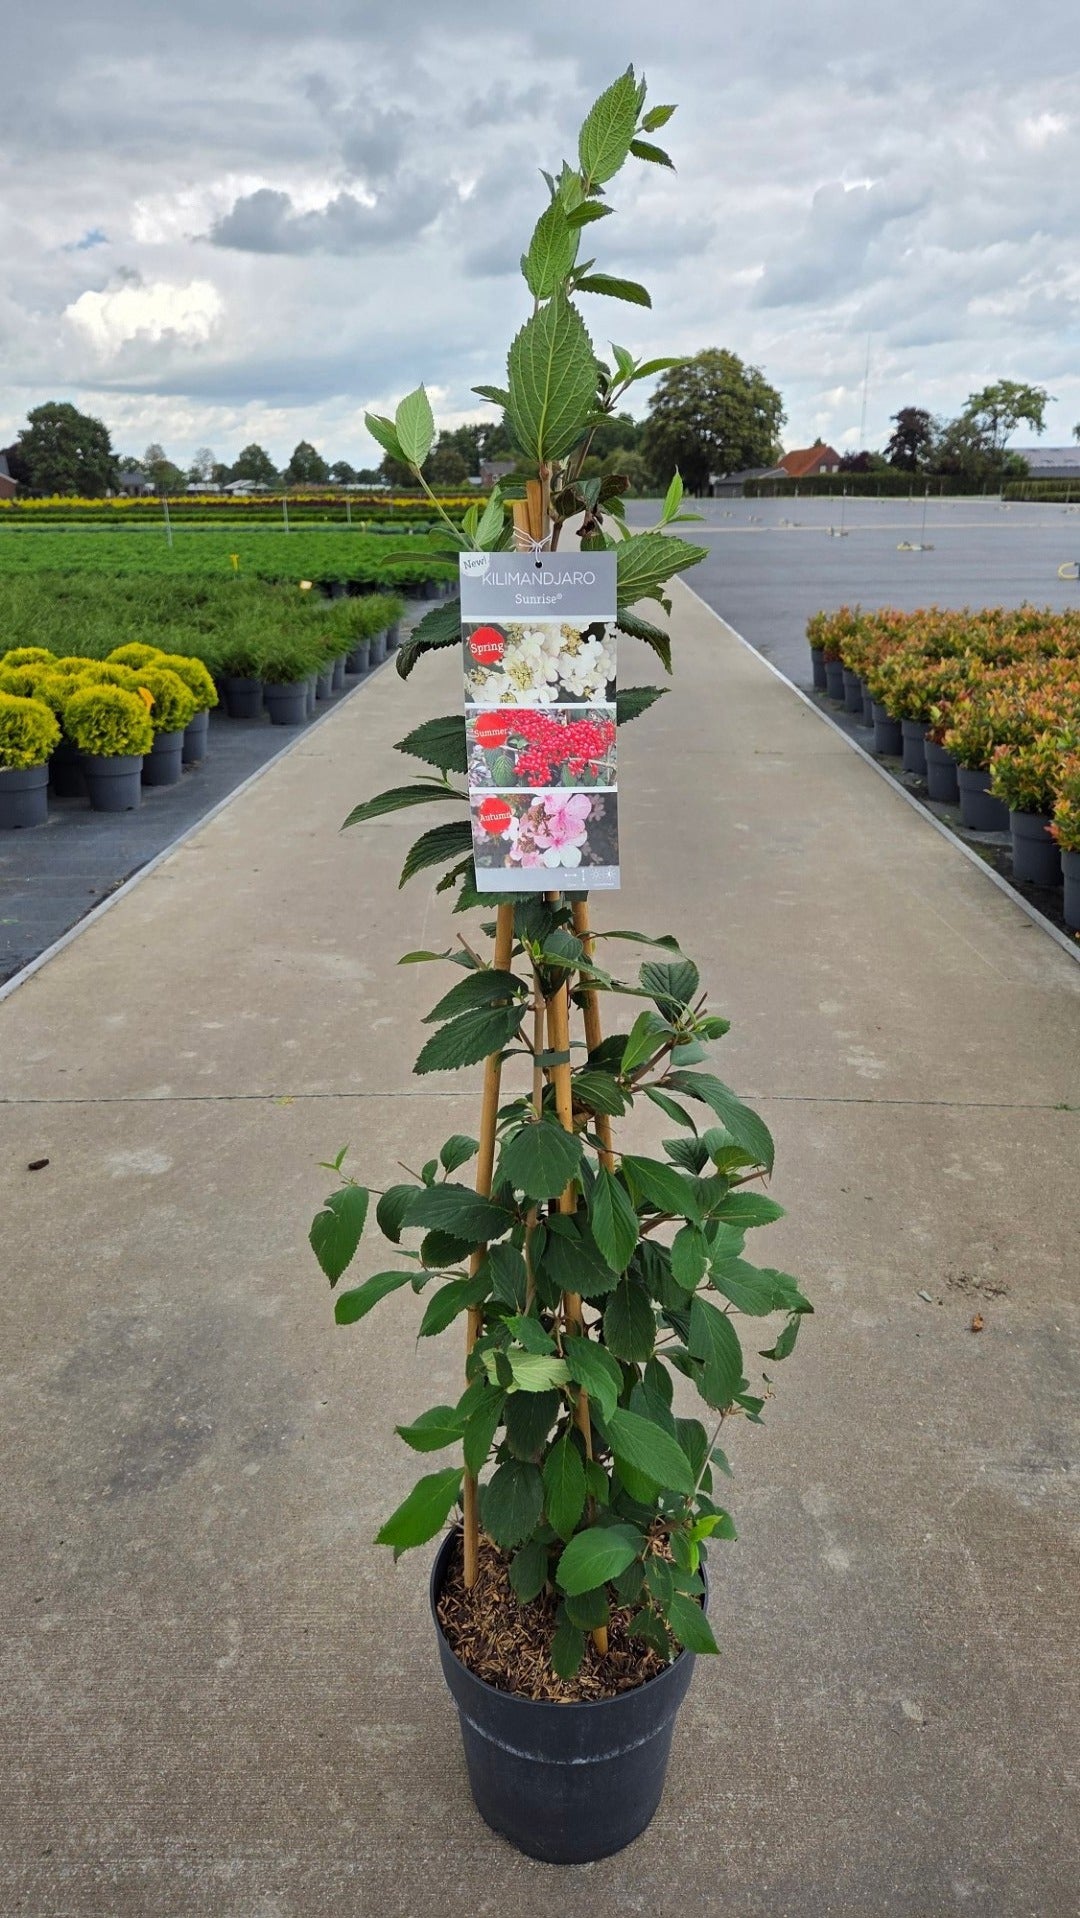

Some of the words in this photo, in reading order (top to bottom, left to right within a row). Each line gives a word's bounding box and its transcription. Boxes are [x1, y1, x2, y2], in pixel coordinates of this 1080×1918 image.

[482, 571, 596, 586] KILIMANDJARO
[470, 642, 505, 655] Spring
[473, 728, 508, 737] Summer
[479, 811, 513, 822] Autumn
